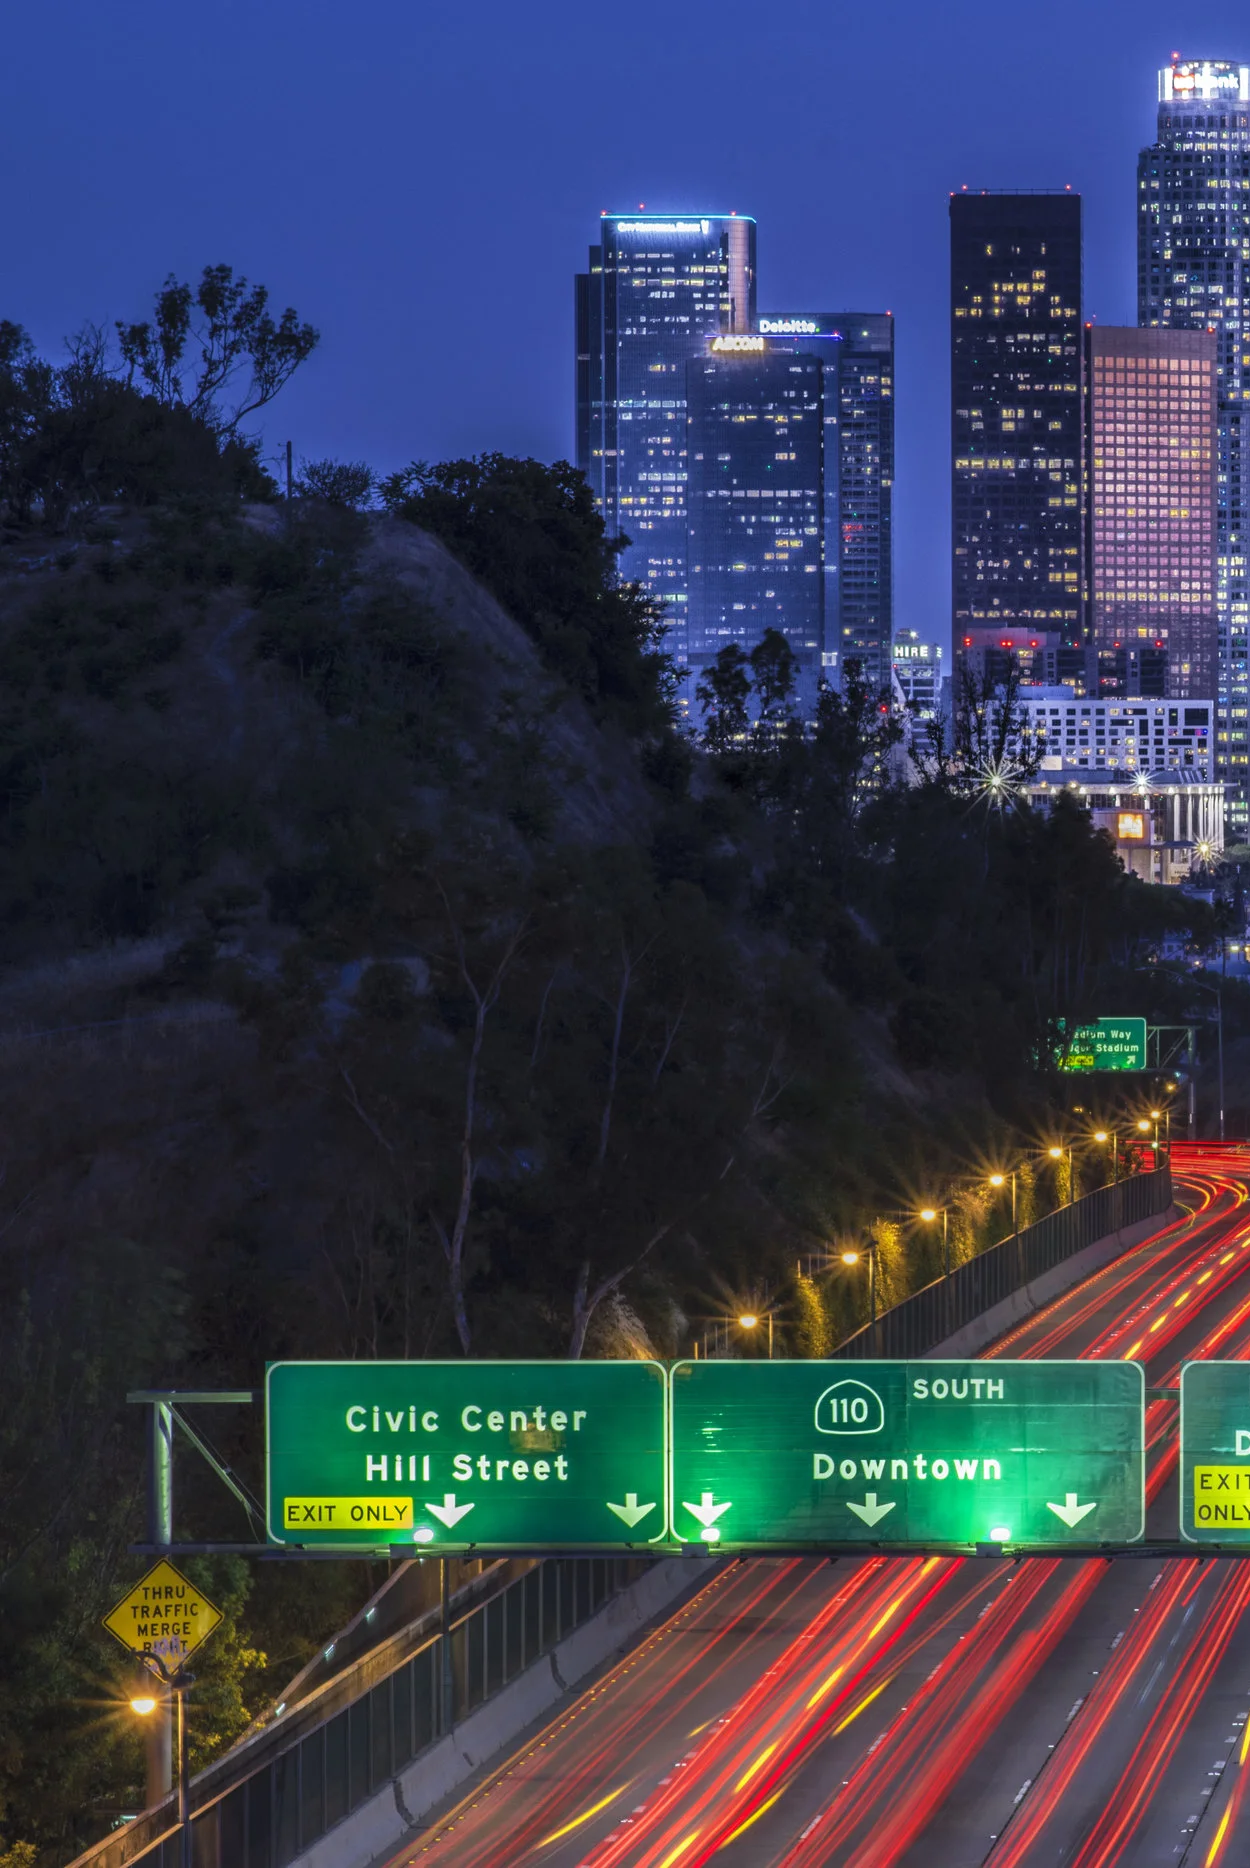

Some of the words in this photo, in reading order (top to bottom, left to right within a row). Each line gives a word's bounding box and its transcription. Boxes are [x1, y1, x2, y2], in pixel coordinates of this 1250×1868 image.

[895, 646, 928, 657] HIRE
[1111, 1030, 1131, 1041] Way
[1096, 1044, 1139, 1052] Stadium
[913, 1378, 1004, 1400] SOUTH
[346, 1405, 439, 1433] Civic
[461, 1405, 588, 1433] Center
[830, 1397, 868, 1424] 110
[366, 1454, 431, 1482] Hill
[452, 1453, 569, 1482] Street
[812, 1453, 1002, 1481] Downtown
[287, 1505, 336, 1522] EXIT
[350, 1504, 409, 1522] ONLY
[142, 1585, 186, 1600] THRU
[131, 1603, 199, 1619] TRAFFIC
[137, 1622, 191, 1637] MERGE
